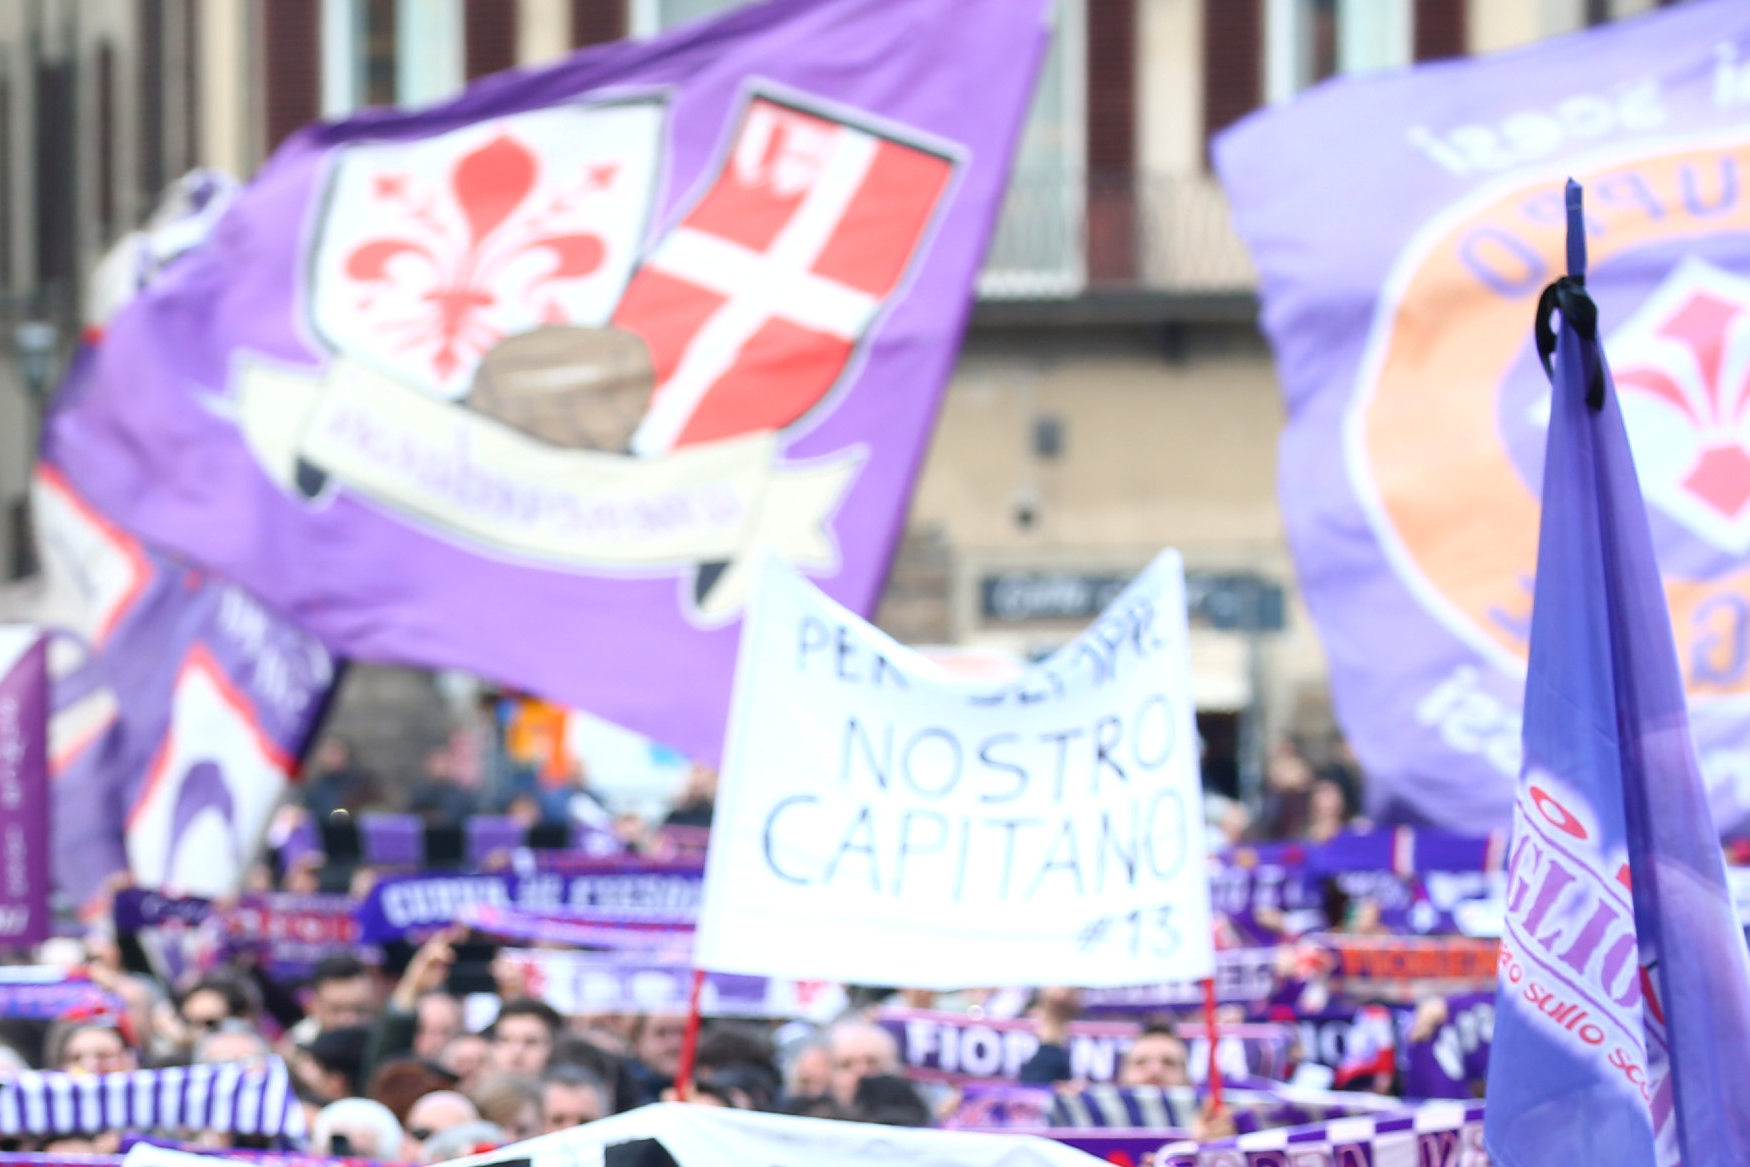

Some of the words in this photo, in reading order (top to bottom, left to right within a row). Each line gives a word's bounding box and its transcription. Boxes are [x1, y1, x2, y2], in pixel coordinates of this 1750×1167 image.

[844, 692, 1176, 804] NOSTRO
[762, 788, 1188, 904] CAPITANO
[1076, 903, 1183, 960] #13
[1522, 975, 1606, 1048] sullo
